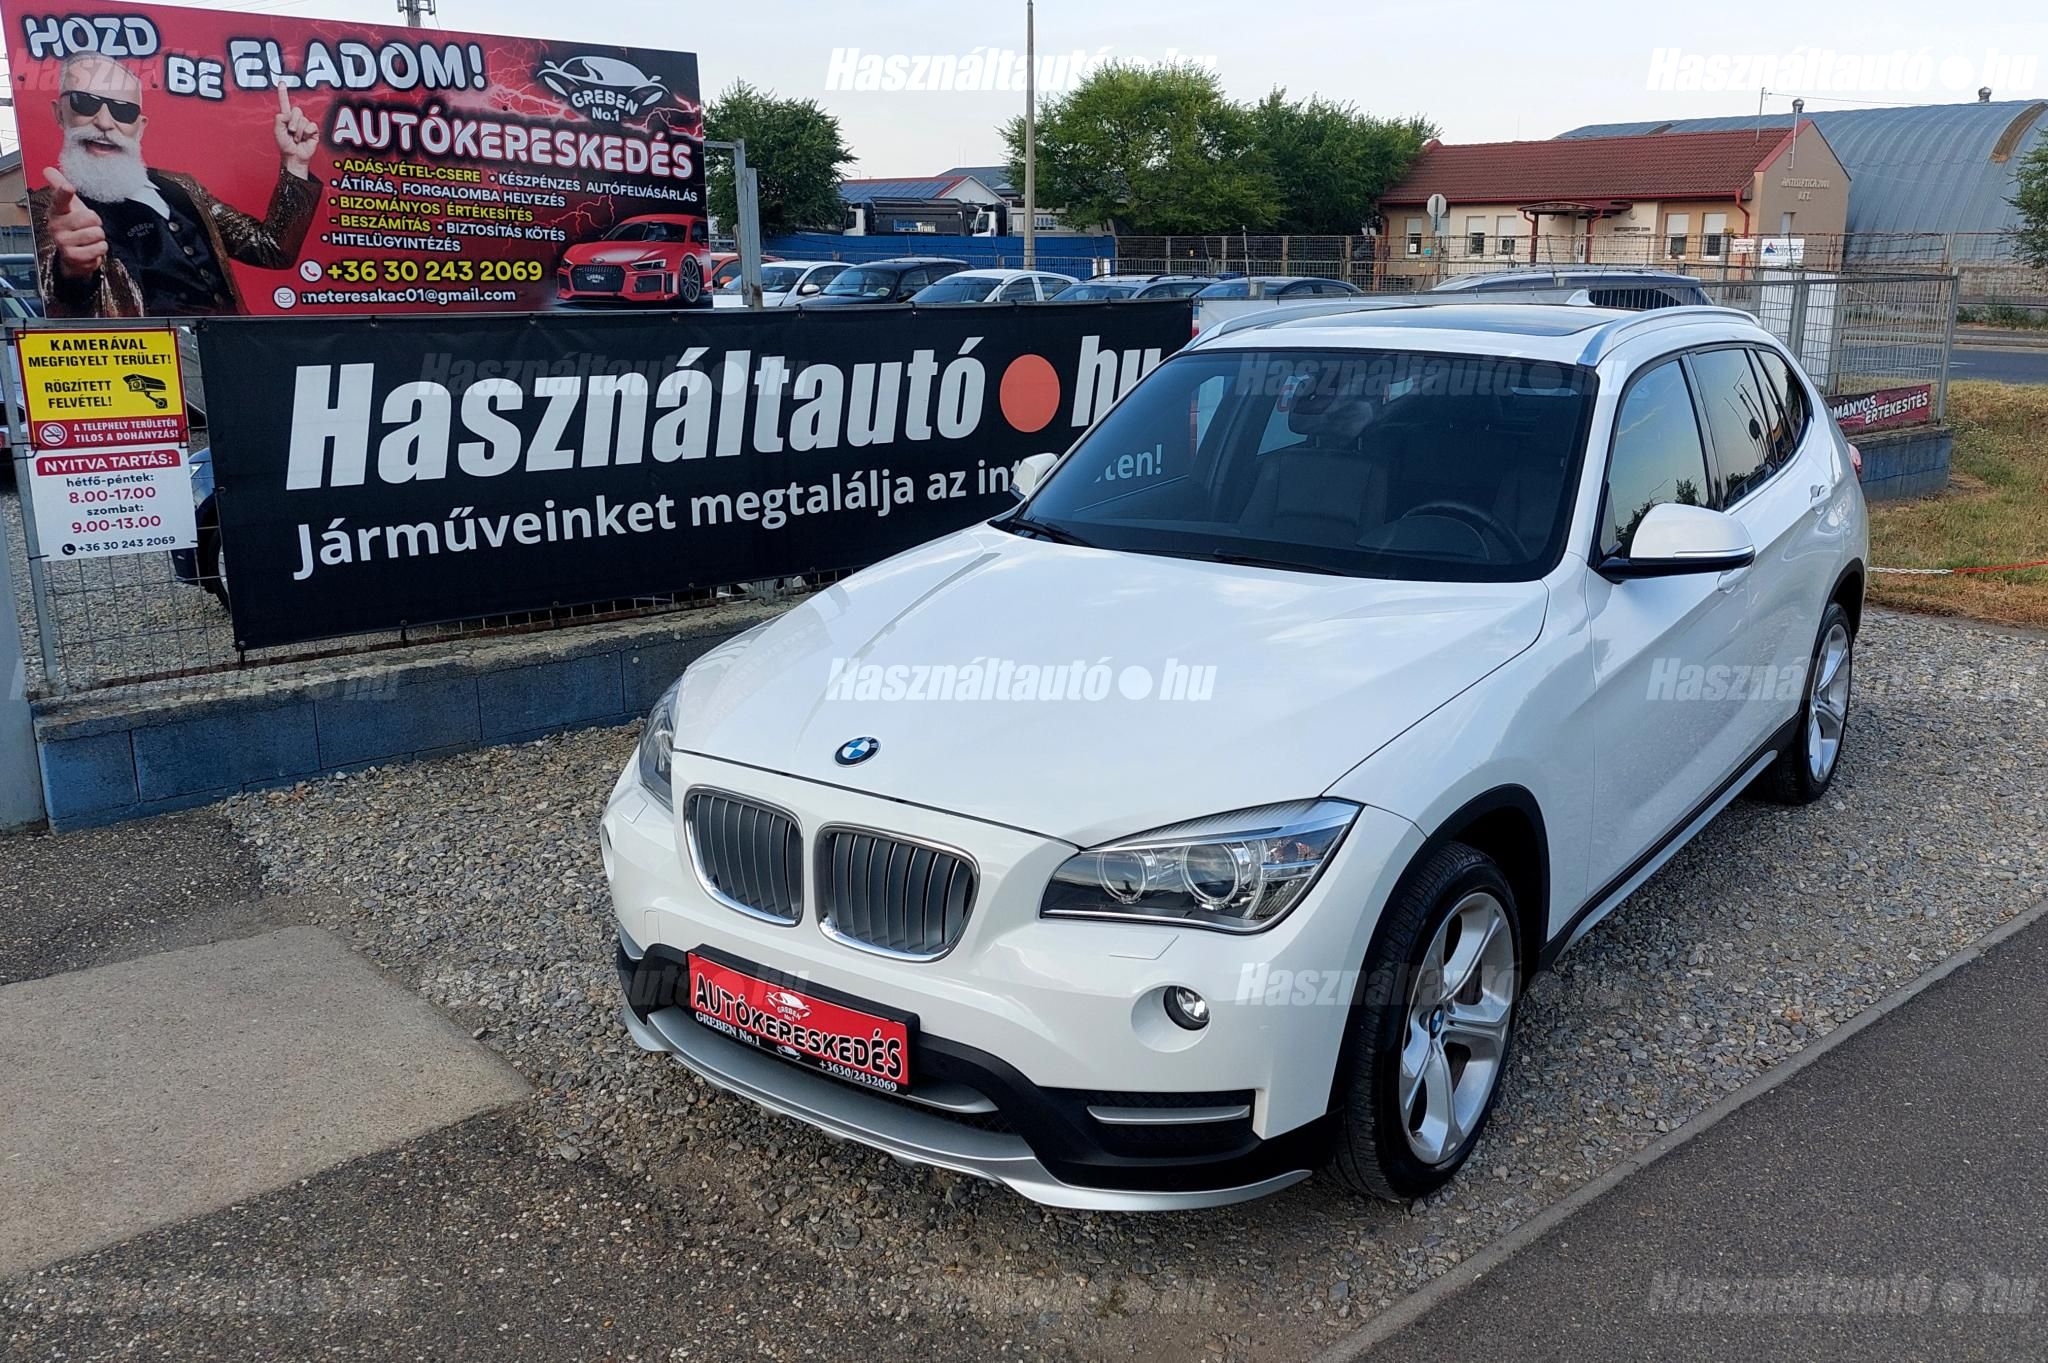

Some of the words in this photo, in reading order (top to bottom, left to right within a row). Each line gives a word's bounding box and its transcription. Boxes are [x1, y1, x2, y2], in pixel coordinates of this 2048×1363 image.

[24, 16, 159, 58] HOZD
[167, 57, 224, 98] BE
[230, 40, 485, 89] ELADOM!
[571, 89, 638, 115] GREBEN
[592, 107, 619, 121] No.1
[333, 105, 693, 178] AUTÓKERESKEDÉS
[340, 174, 398, 195] ÁTÍRÁS,
[402, 183, 500, 201] FORGALOMBA
[503, 191, 566, 208] HELYEZÉS
[343, 160, 482, 183] ADÁS-VÉTEL-CSERE
[498, 171, 581, 192] KÉSZPÉNZES
[586, 180, 698, 203] AUTÓFELVÁSÁRLÁS
[340, 196, 441, 215] BIZOMÁNYOS
[446, 201, 534, 222] ÉRTÉKESÍTÉS
[340, 214, 431, 232] BESZÁMÍTÁS
[446, 221, 522, 239] BIZTOSÍTÁS
[525, 226, 566, 242] KÖTÉS
[331, 232, 462, 252] HITELÜGYINTÉZÉS
[326, 260, 377, 282] +36
[383, 260, 419, 281] 30
[425, 260, 474, 281] 243
[480, 260, 543, 281] 2069
[301, 288, 516, 305] meteresakac01@gmail.com
[49, 335, 148, 352] KAMERÁVAL
[28, 355, 109, 368] MEGFIGYELT
[114, 351, 171, 366] TERÜLET!
[44, 378, 112, 393] RÖGZÍTETT
[48, 393, 112, 409] FELVÉTEL!
[1831, 394, 1877, 419] MÁNYOS
[74, 423, 80, 432] A
[82, 420, 129, 431] TELEPHELY
[131, 417, 178, 429] TERÜLETÉN
[286, 336, 985, 491] Használtautó
[74, 433, 104, 443] TILOS
[106, 432, 114, 441] A
[116, 429, 179, 441] DOHÁNYZÁS!
[44, 457, 108, 474] NYITVA
[110, 451, 173, 468] TARTÁS:
[69, 486, 157, 504] 8.00-17.00
[86, 502, 144, 517] szombat:
[71, 515, 162, 534] 9.00-13.00
[293, 493, 676, 581] Járműveinket
[691, 468, 914, 531] megtalálja
[926, 469, 967, 501] az
[78, 542, 101, 553] +36
[103, 540, 119, 551] 30
[122, 538, 144, 549] 243
[146, 535, 176, 547] 2069
[694, 972, 903, 1078] AUTÓKERESKEDÉS
[695, 1011, 737, 1038] GREBEN
[739, 1030, 761, 1046] No.1
[819, 1059, 898, 1093] +3630/2432069
